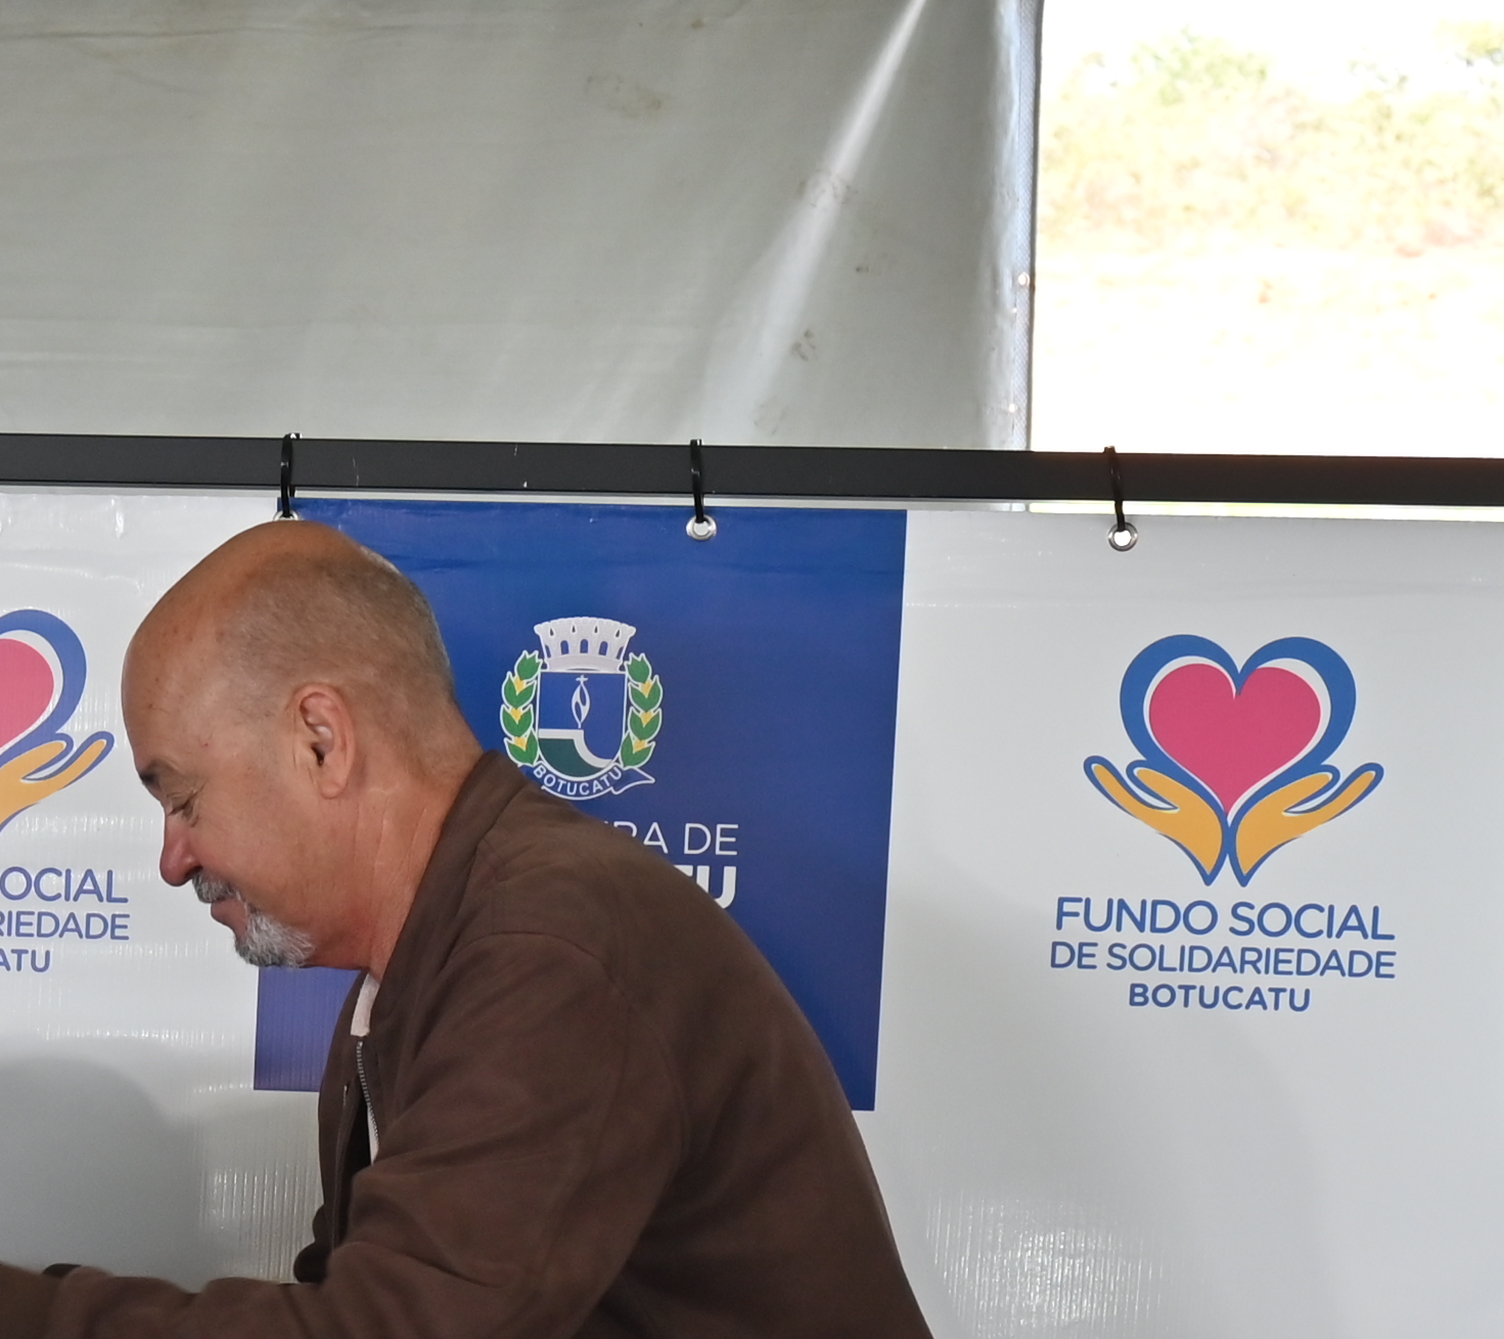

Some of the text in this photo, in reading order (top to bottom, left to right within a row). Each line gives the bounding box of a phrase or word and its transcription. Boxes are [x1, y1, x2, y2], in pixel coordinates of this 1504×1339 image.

[532, 763, 623, 796] BOTUCATU
[682, 821, 740, 857] DE
[1055, 895, 1396, 942] FUNDO SOCIAL
[1050, 940, 1398, 980] DE SOLIDARIEDADE
[1128, 982, 1312, 1013] BOTUCATU
